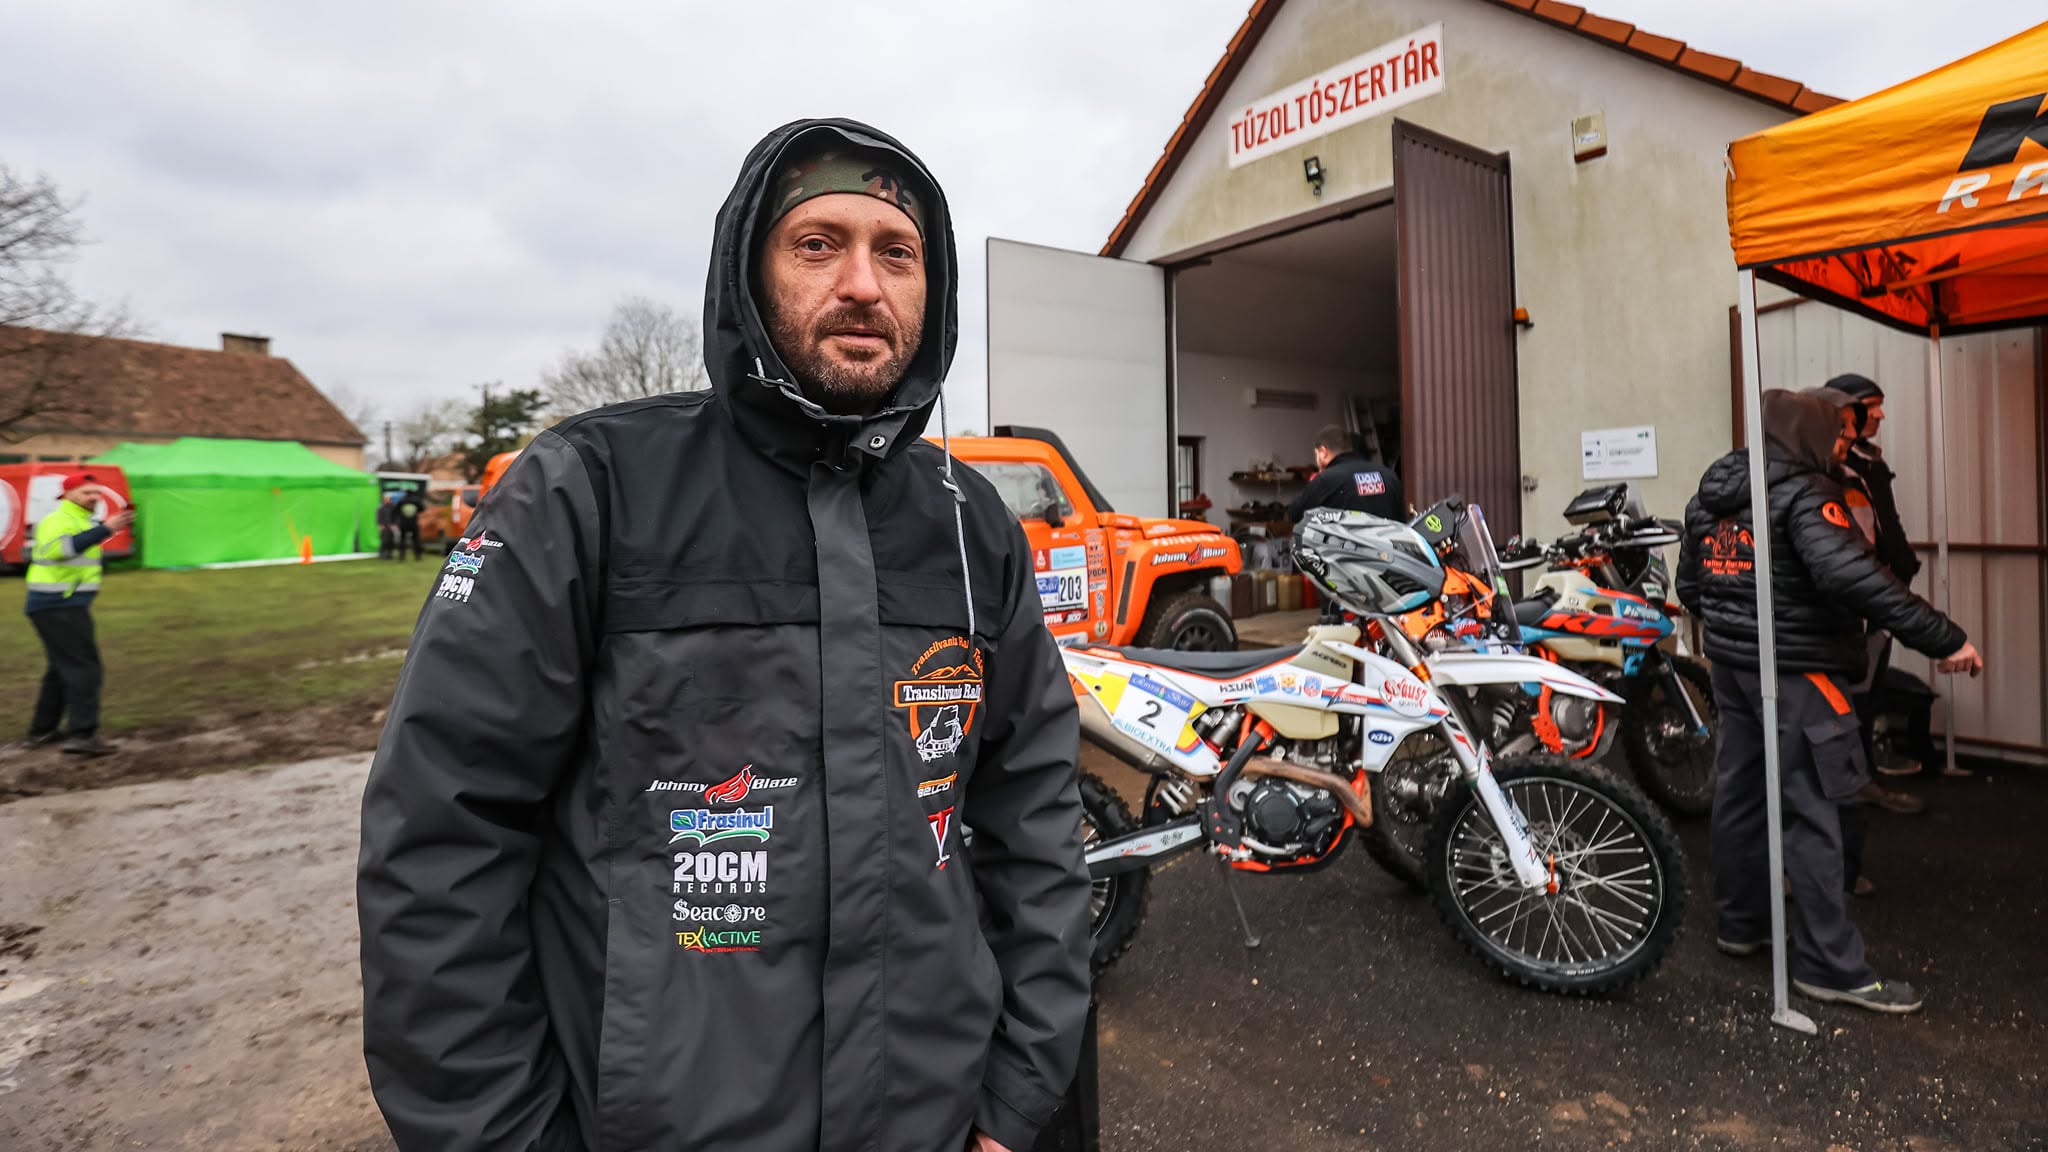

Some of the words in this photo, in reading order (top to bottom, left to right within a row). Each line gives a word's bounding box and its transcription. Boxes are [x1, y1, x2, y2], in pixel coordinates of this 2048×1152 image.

[1359, 482, 1385, 495] MOLY
[1060, 574, 1083, 602] 203
[903, 684, 962, 702] Transilvania
[1137, 700, 1163, 729] 2
[645, 779, 709, 793] Johnny
[751, 777, 798, 791] Blaze
[697, 806, 774, 831] Frasinul
[673, 851, 768, 882] 20CM
[673, 882, 767, 894] RECORDS
